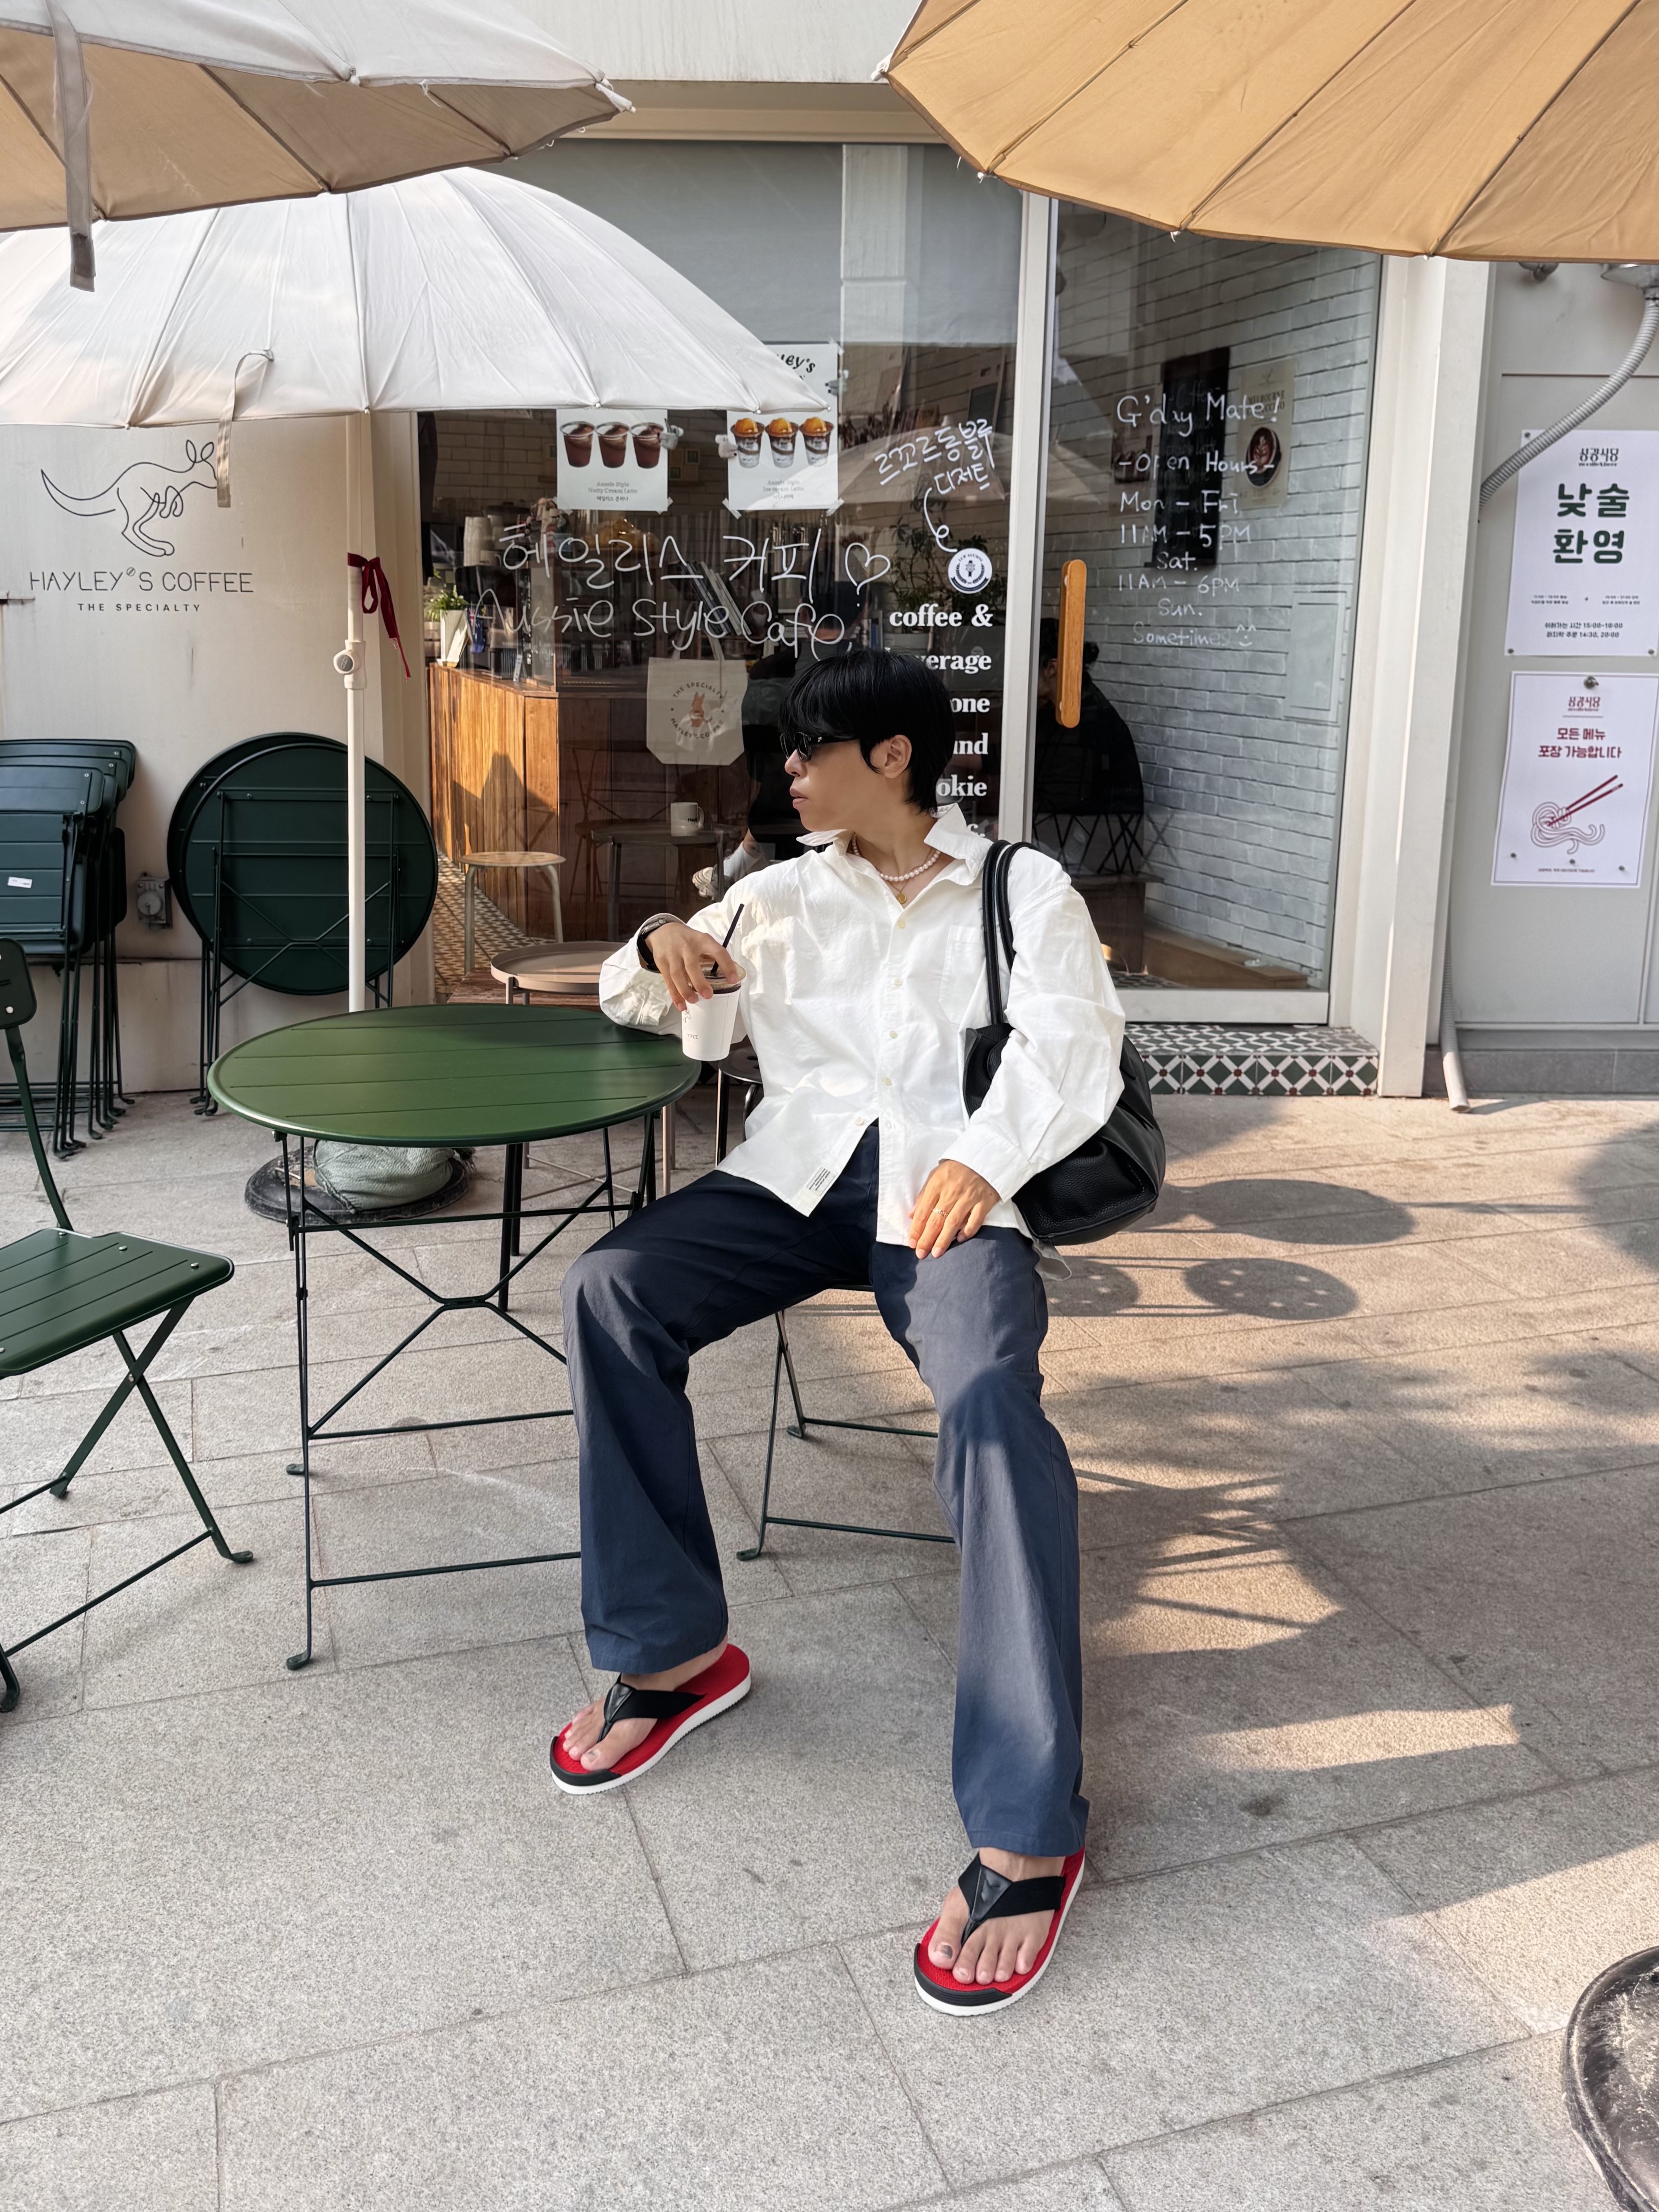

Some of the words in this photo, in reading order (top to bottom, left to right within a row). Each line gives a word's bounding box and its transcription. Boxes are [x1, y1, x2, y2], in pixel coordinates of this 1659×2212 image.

[1206, 392, 1280, 422] Mate!
[934, 463, 990, 495] 디저트
[1120, 492, 1165, 512] Mon
[1201, 490, 1239, 514] Fri
[1557, 483, 1630, 517] 낮술
[1121, 523, 1168, 544] 11AM
[1199, 524, 1252, 551] 5PM
[1553, 529, 1625, 563] 환영
[499, 523, 704, 589] 헤일리스
[723, 528, 822, 603] 커피
[1156, 551, 1198, 571] Sat.
[162, 572, 254, 593] COFFEE
[1119, 574, 1167, 591] 11AM
[1198, 575, 1240, 596] 6PM
[78, 603, 105, 612] THE
[116, 603, 201, 612] SPECIALTY
[889, 603, 963, 627] coffee
[971, 604, 993, 627] &
[1158, 598, 1202, 616] Sun.
[473, 588, 614, 638] Aussie
[632, 598, 729, 651] Style
[673, 687, 684, 698] THE
[1556, 728, 1580, 740] 모든
[1583, 728, 1606, 740] 메뉴
[1537, 745, 1562, 758] 포장
[1565, 746, 1622, 759] 가능합니다
